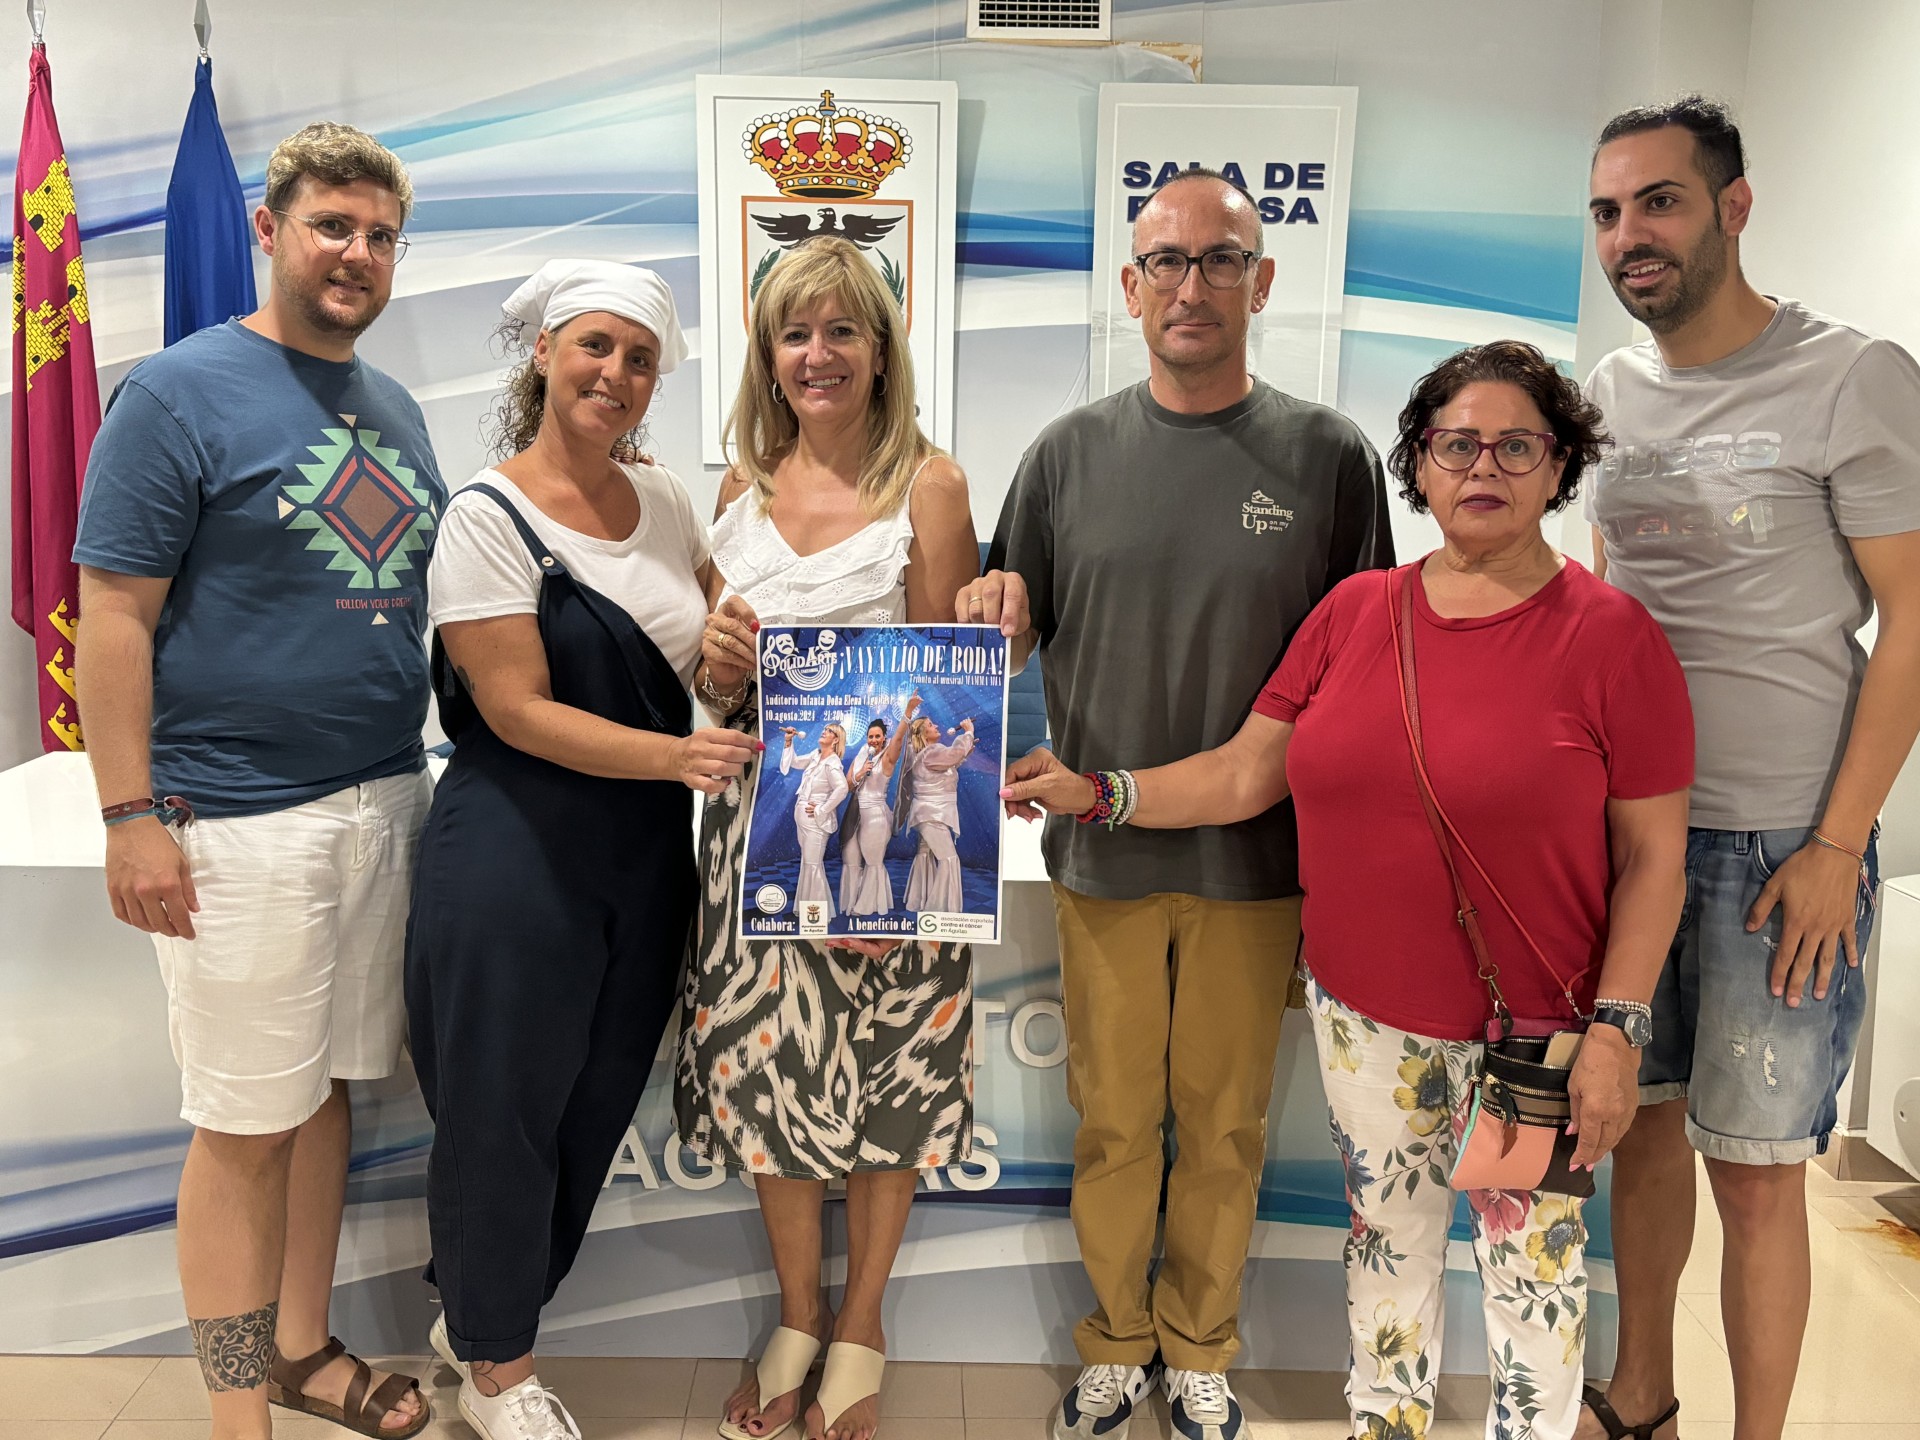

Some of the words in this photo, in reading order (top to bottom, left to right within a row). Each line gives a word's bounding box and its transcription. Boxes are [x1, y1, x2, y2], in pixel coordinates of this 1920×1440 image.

[1122, 160, 1248, 190] SAA
[1264, 162, 1325, 191] DE
[1241, 501, 1294, 521] Standing
[1241, 513, 1268, 535] Up
[335, 598, 368, 609] FOLLOW
[369, 598, 390, 609] YOUR
[890, 639, 919, 673] LÍO
[922, 645, 946, 673] DE
[951, 644, 1004, 676] BODA!
[765, 694, 799, 706] Auditorio
[799, 694, 825, 706] Infanta
[844, 695, 862, 706] Elena
[750, 917, 796, 932] Colabora:
[847, 918, 854, 931] A
[856, 917, 899, 931] beneficio
[901, 917, 915, 931] de:
